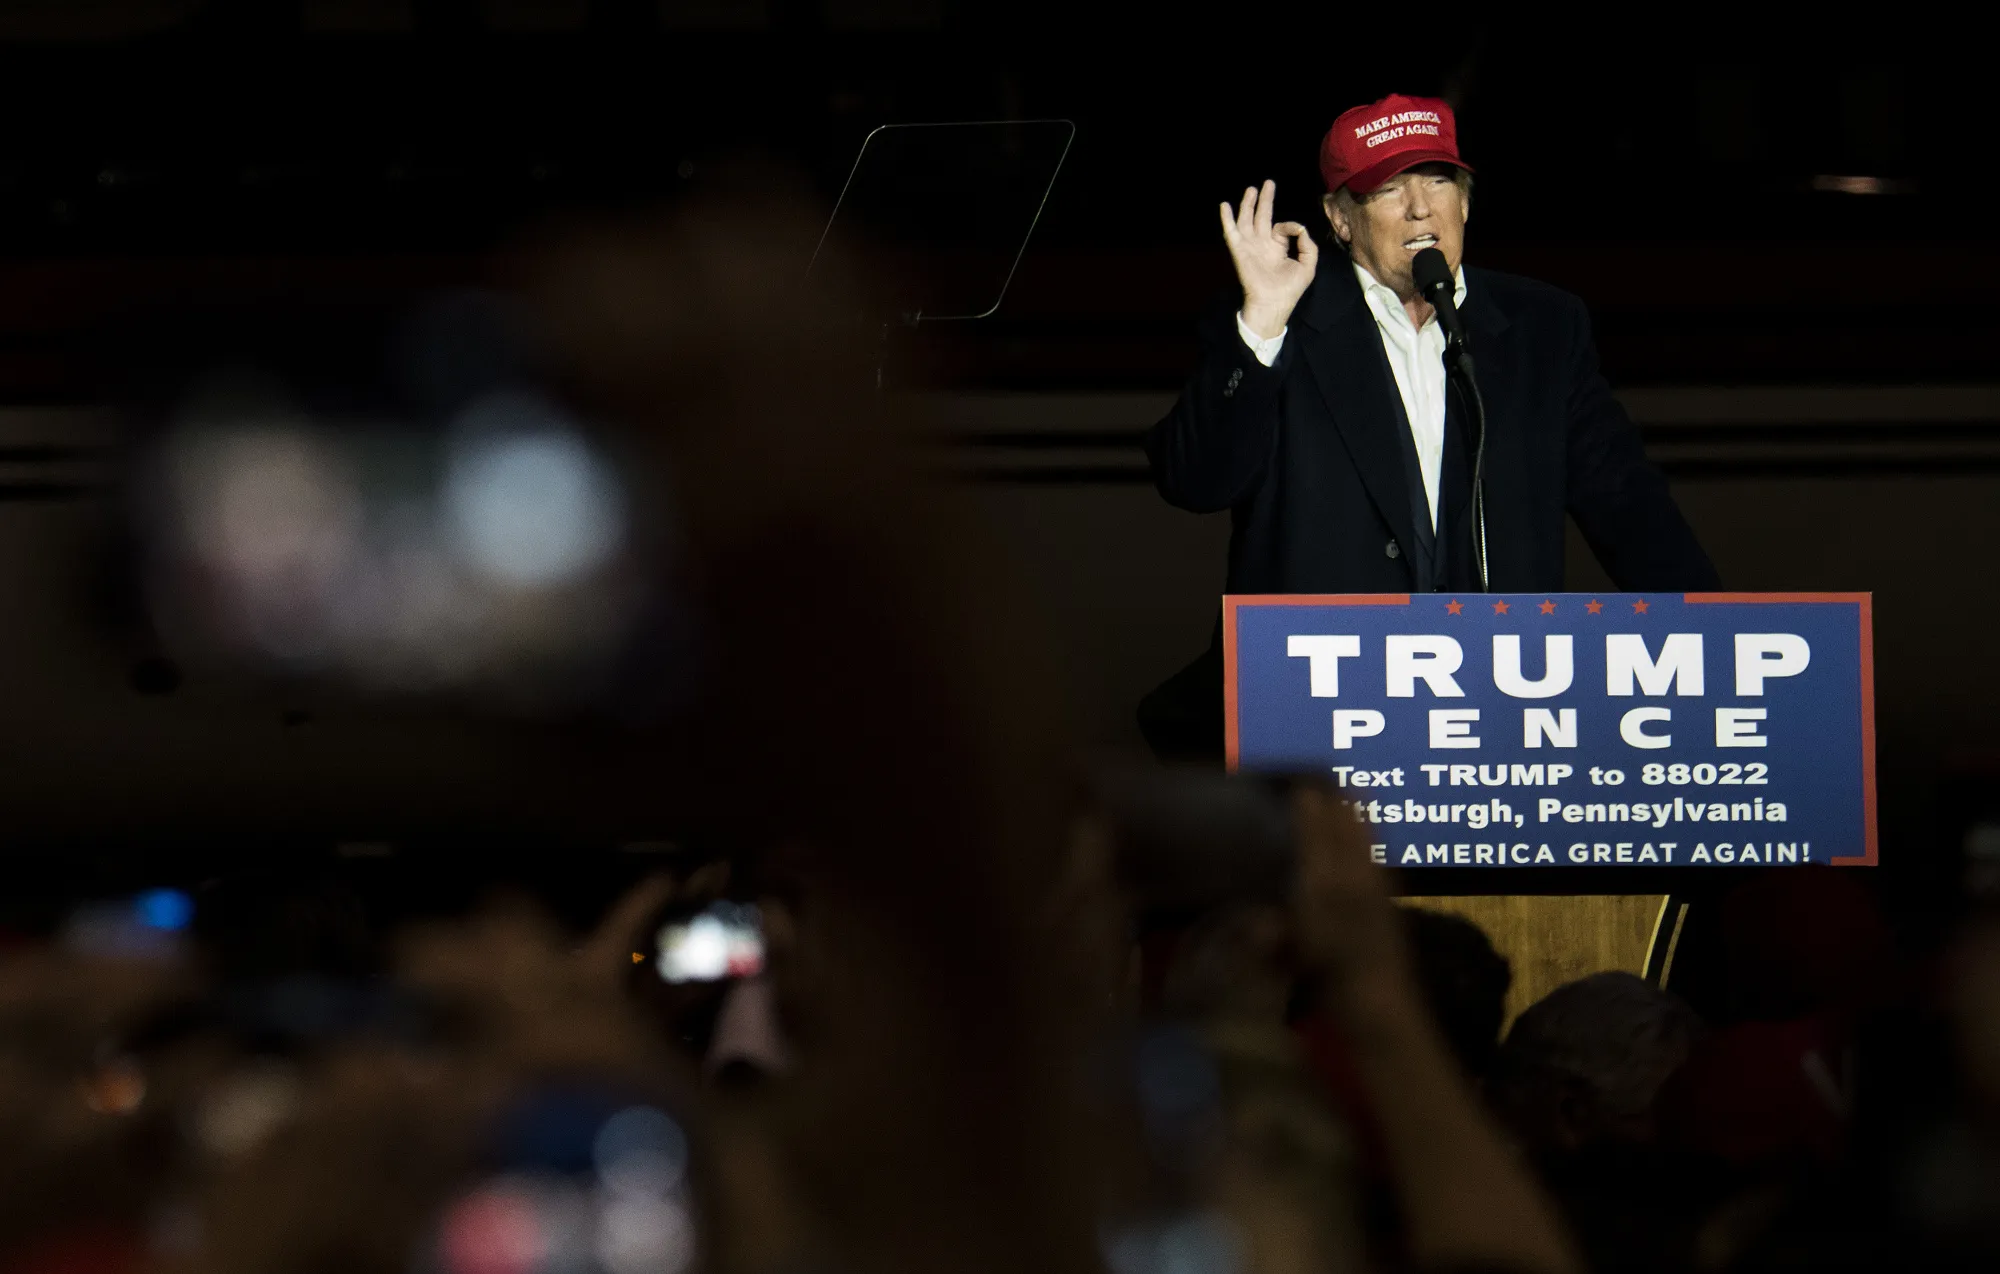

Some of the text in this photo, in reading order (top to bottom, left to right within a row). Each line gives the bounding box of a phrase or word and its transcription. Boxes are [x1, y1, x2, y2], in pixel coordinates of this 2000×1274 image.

[1354, 111, 1441, 138] MAKE AMERICA
[1366, 124, 1439, 148] GREAT AGAIN
[1287, 634, 1810, 698] TRUMP
[1333, 707, 1768, 750] PENCE
[1332, 763, 1768, 787] Text TRUMP to 88022
[1341, 798, 1787, 829] ttsburgh, Pennsylvania
[1401, 843, 1555, 864] AMERICA
[1569, 843, 1676, 863] GREAT
[1691, 843, 1810, 863] AGAIN!
